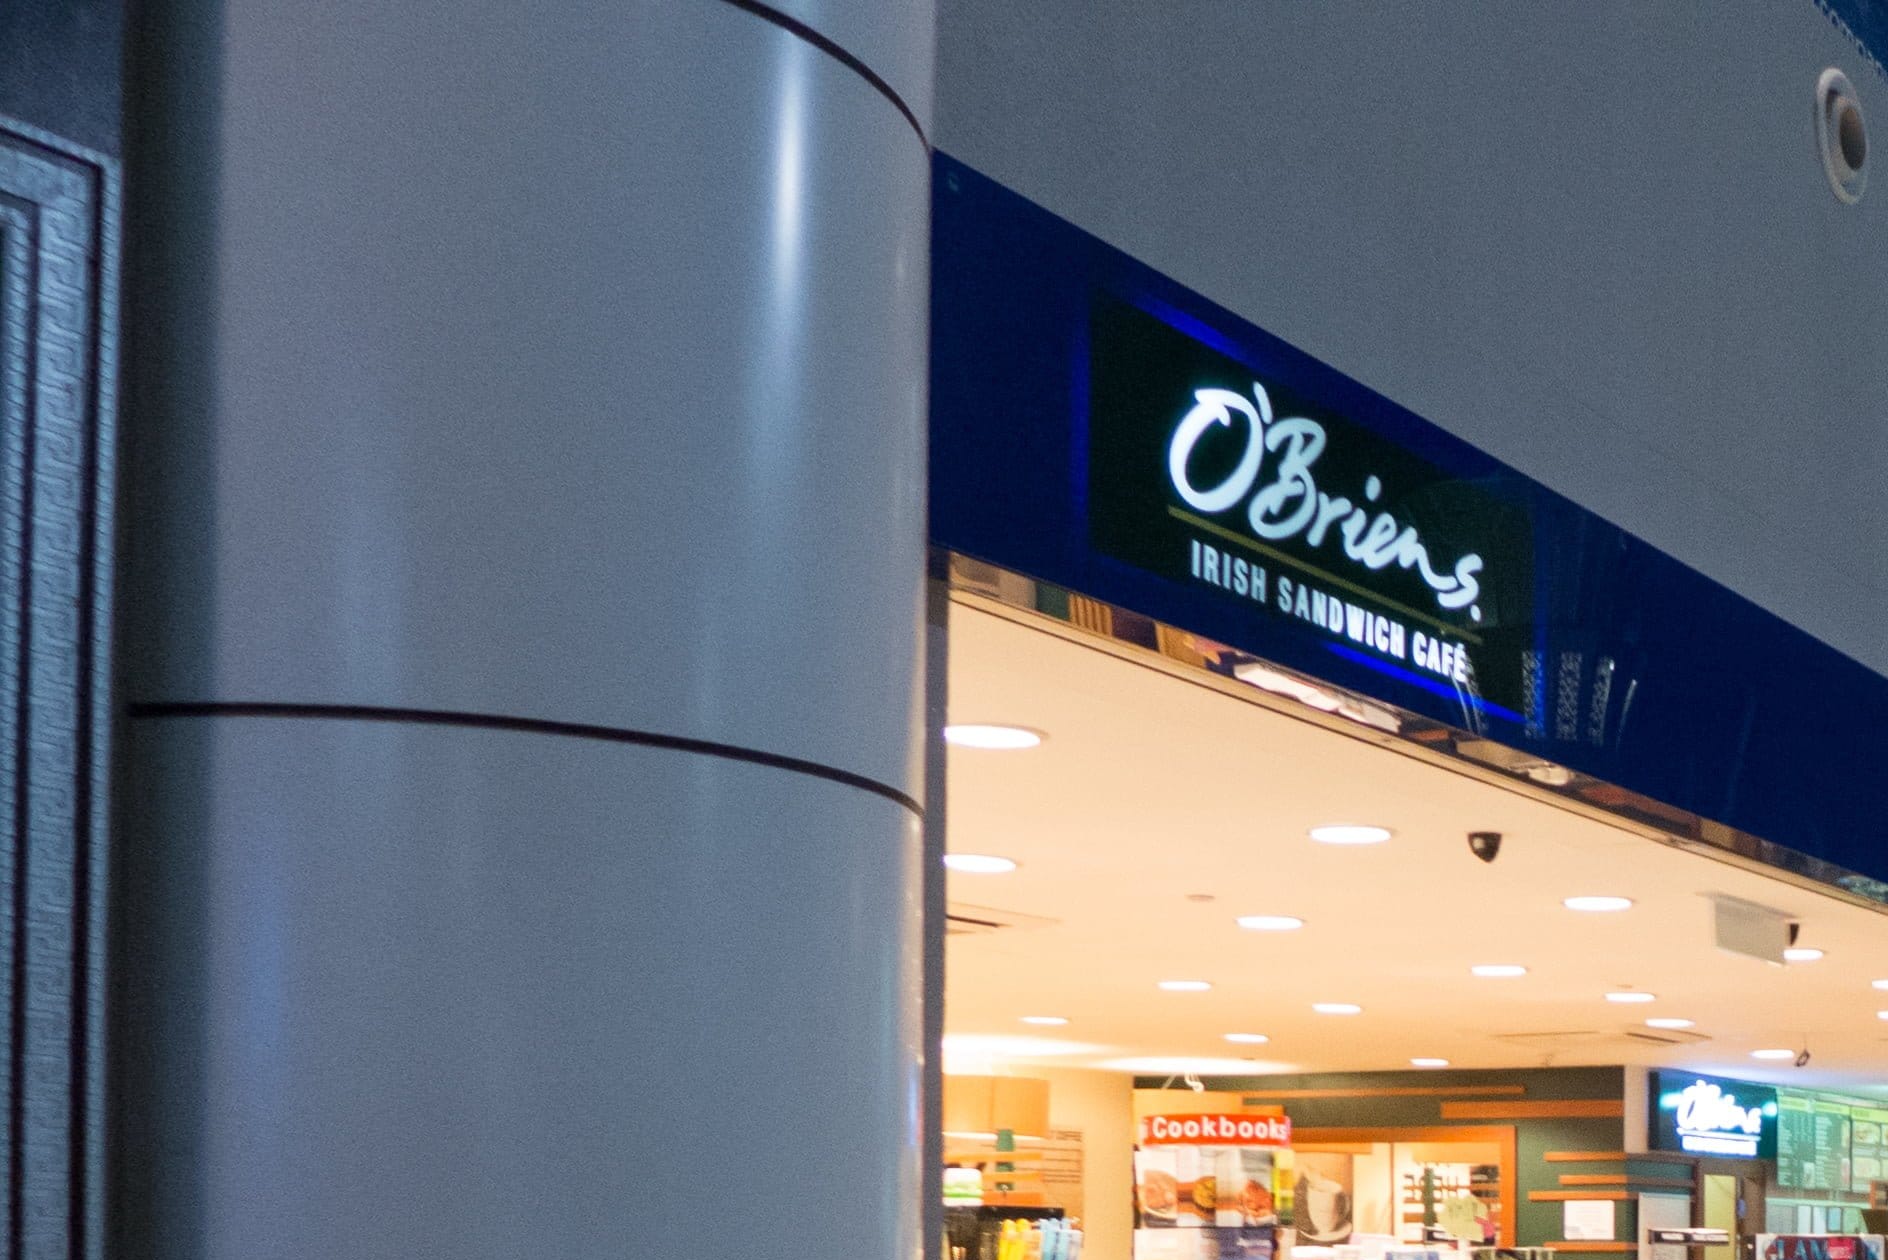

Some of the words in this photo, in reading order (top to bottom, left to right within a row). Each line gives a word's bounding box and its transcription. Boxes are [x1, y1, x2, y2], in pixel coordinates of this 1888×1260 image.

[1190, 540, 1268, 604] IRISH
[1278, 576, 1407, 661] SANDWICH
[1412, 629, 1468, 684] CAFÉ
[1152, 1116, 1288, 1140] Cookbooks
